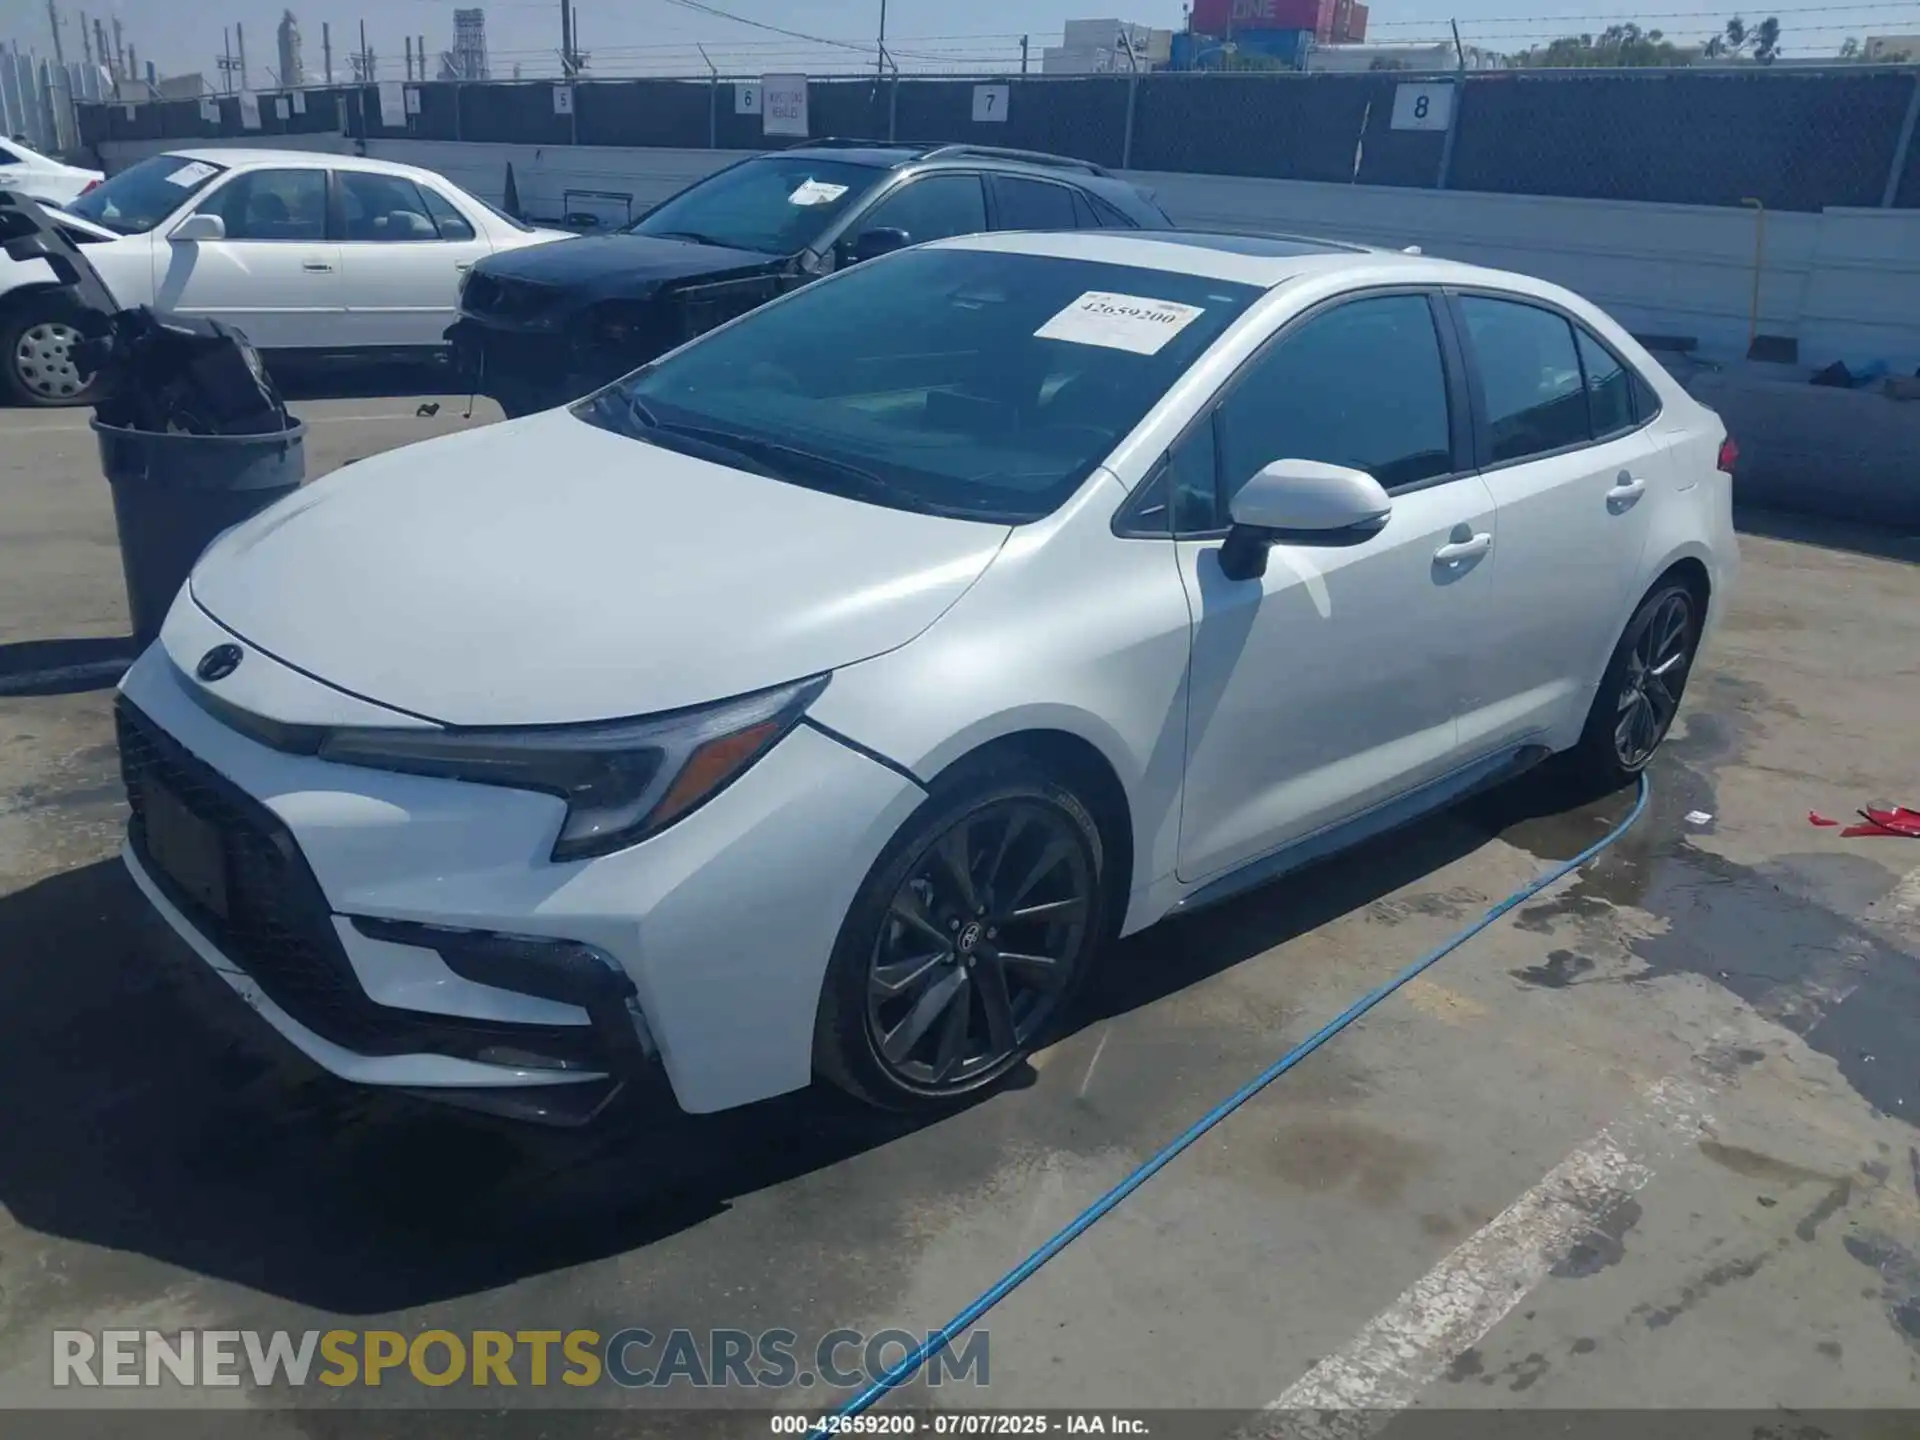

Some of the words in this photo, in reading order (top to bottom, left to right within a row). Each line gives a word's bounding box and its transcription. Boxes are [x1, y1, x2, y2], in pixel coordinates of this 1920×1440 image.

[560, 92, 567, 106] 5
[744, 90, 752, 107] 6
[985, 94, 996, 113] 7
[1414, 95, 1430, 119] 8
[1081, 302, 1176, 324] 42659200
